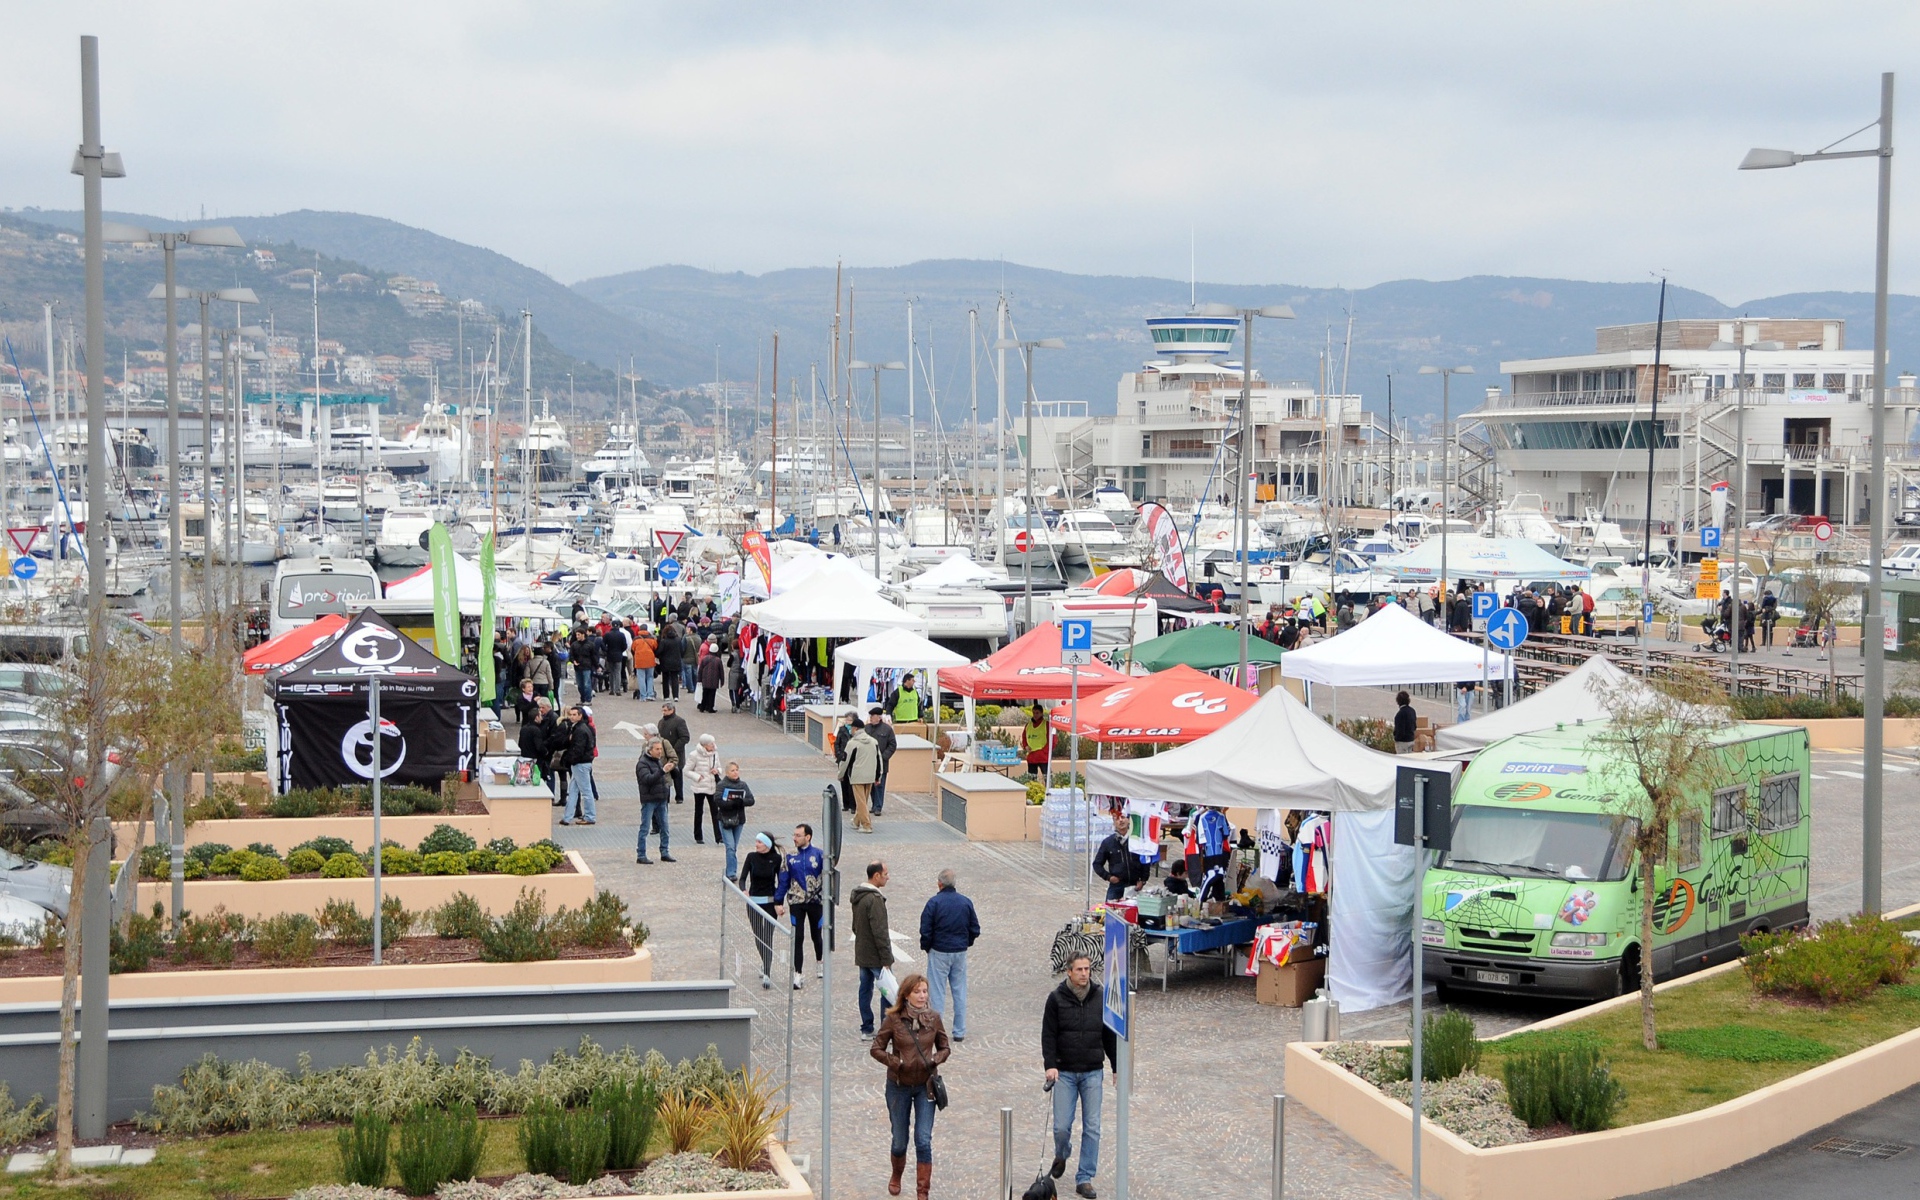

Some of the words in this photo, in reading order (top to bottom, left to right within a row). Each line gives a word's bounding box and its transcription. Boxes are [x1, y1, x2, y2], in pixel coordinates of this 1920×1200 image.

[1704, 530, 1716, 546] P
[1477, 595, 1493, 616] P
[1645, 605, 1651, 621] P
[1068, 623, 1086, 647] P
[312, 665, 438, 677] HERSH
[279, 684, 353, 694] HERSH
[1107, 728, 1142, 736] GAS
[1145, 728, 1181, 736] GAS
[1505, 763, 1555, 773] sprint
